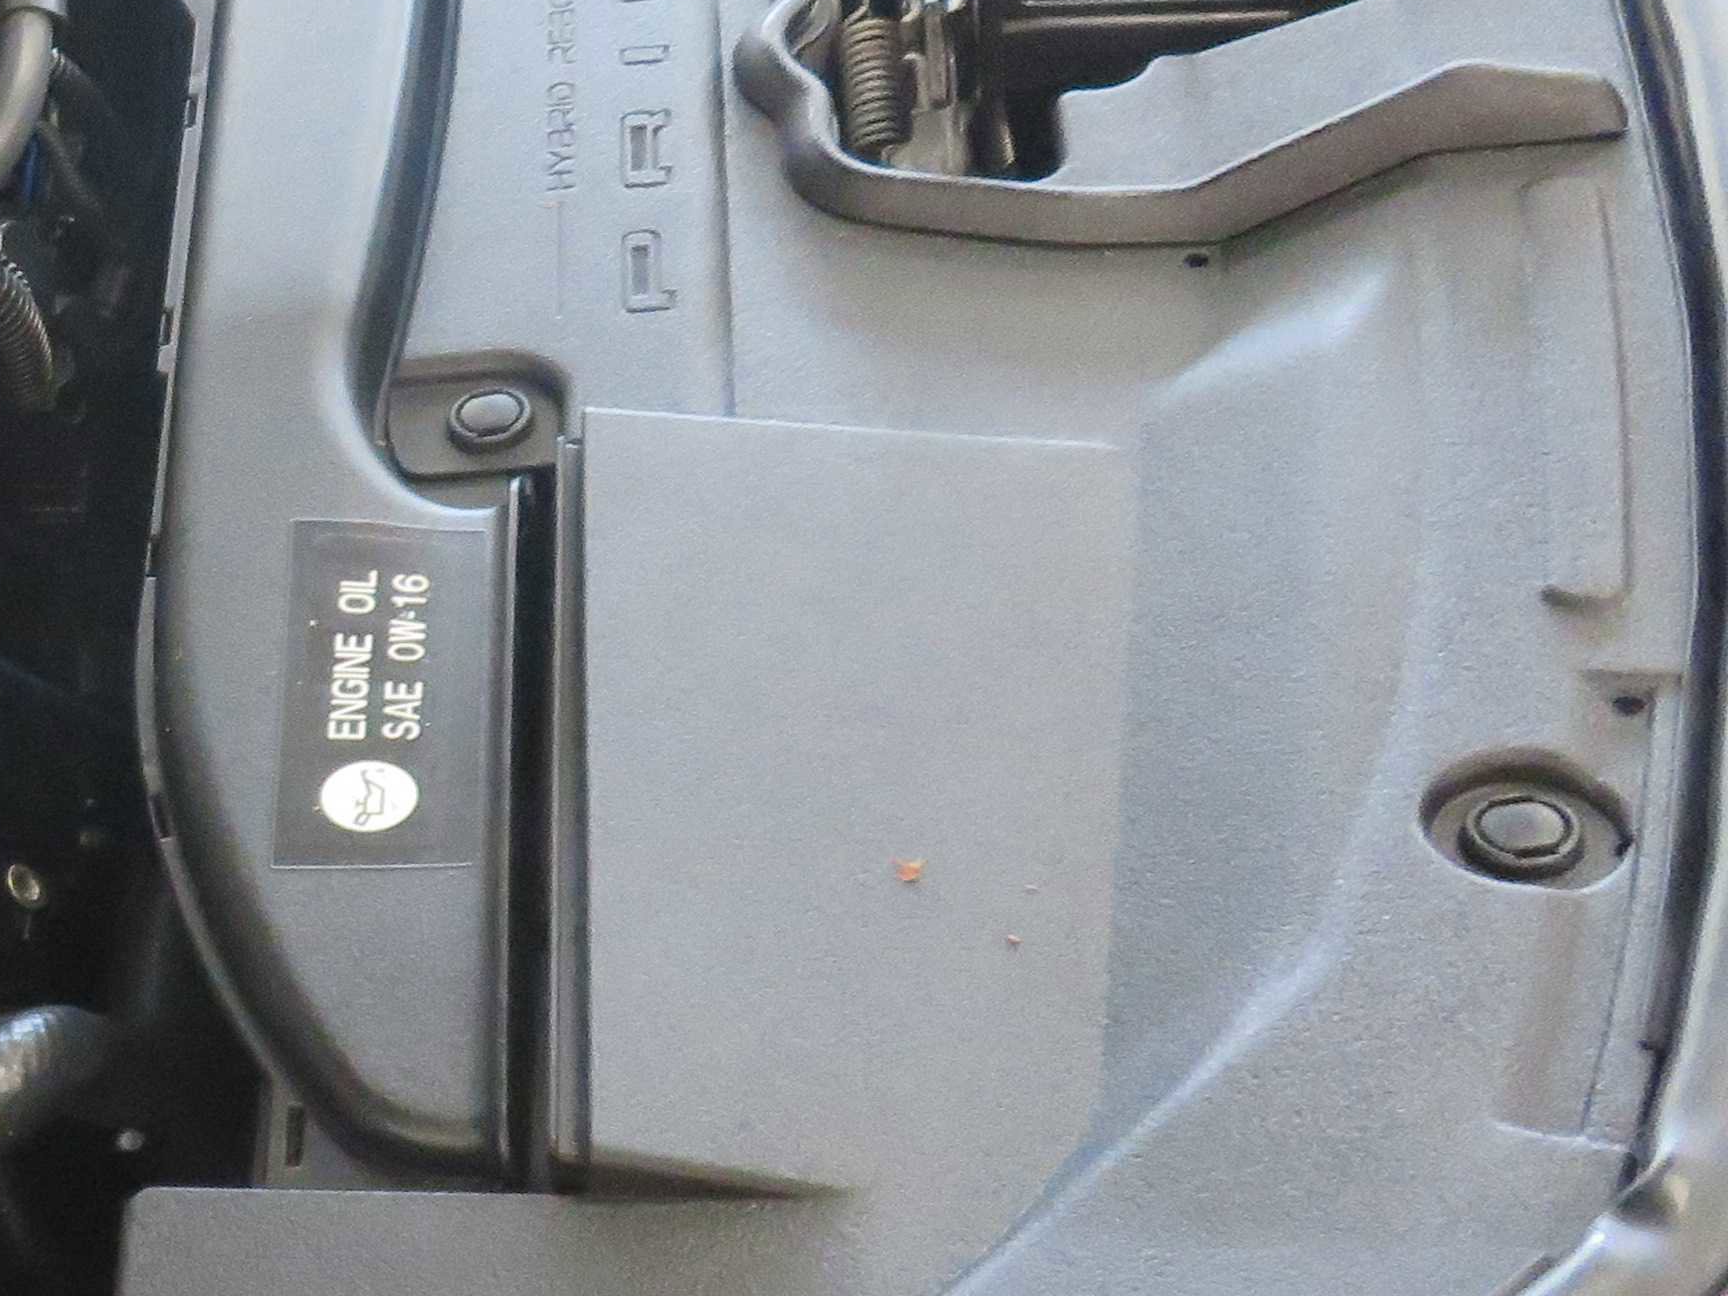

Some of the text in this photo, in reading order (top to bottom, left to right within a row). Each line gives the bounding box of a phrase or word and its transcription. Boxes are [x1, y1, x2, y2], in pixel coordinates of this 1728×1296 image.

[547, 78, 578, 191] HYBRID
[328, 569, 379, 742] ENGINE OIL
[382, 573, 430, 741] SAE 0W-16
